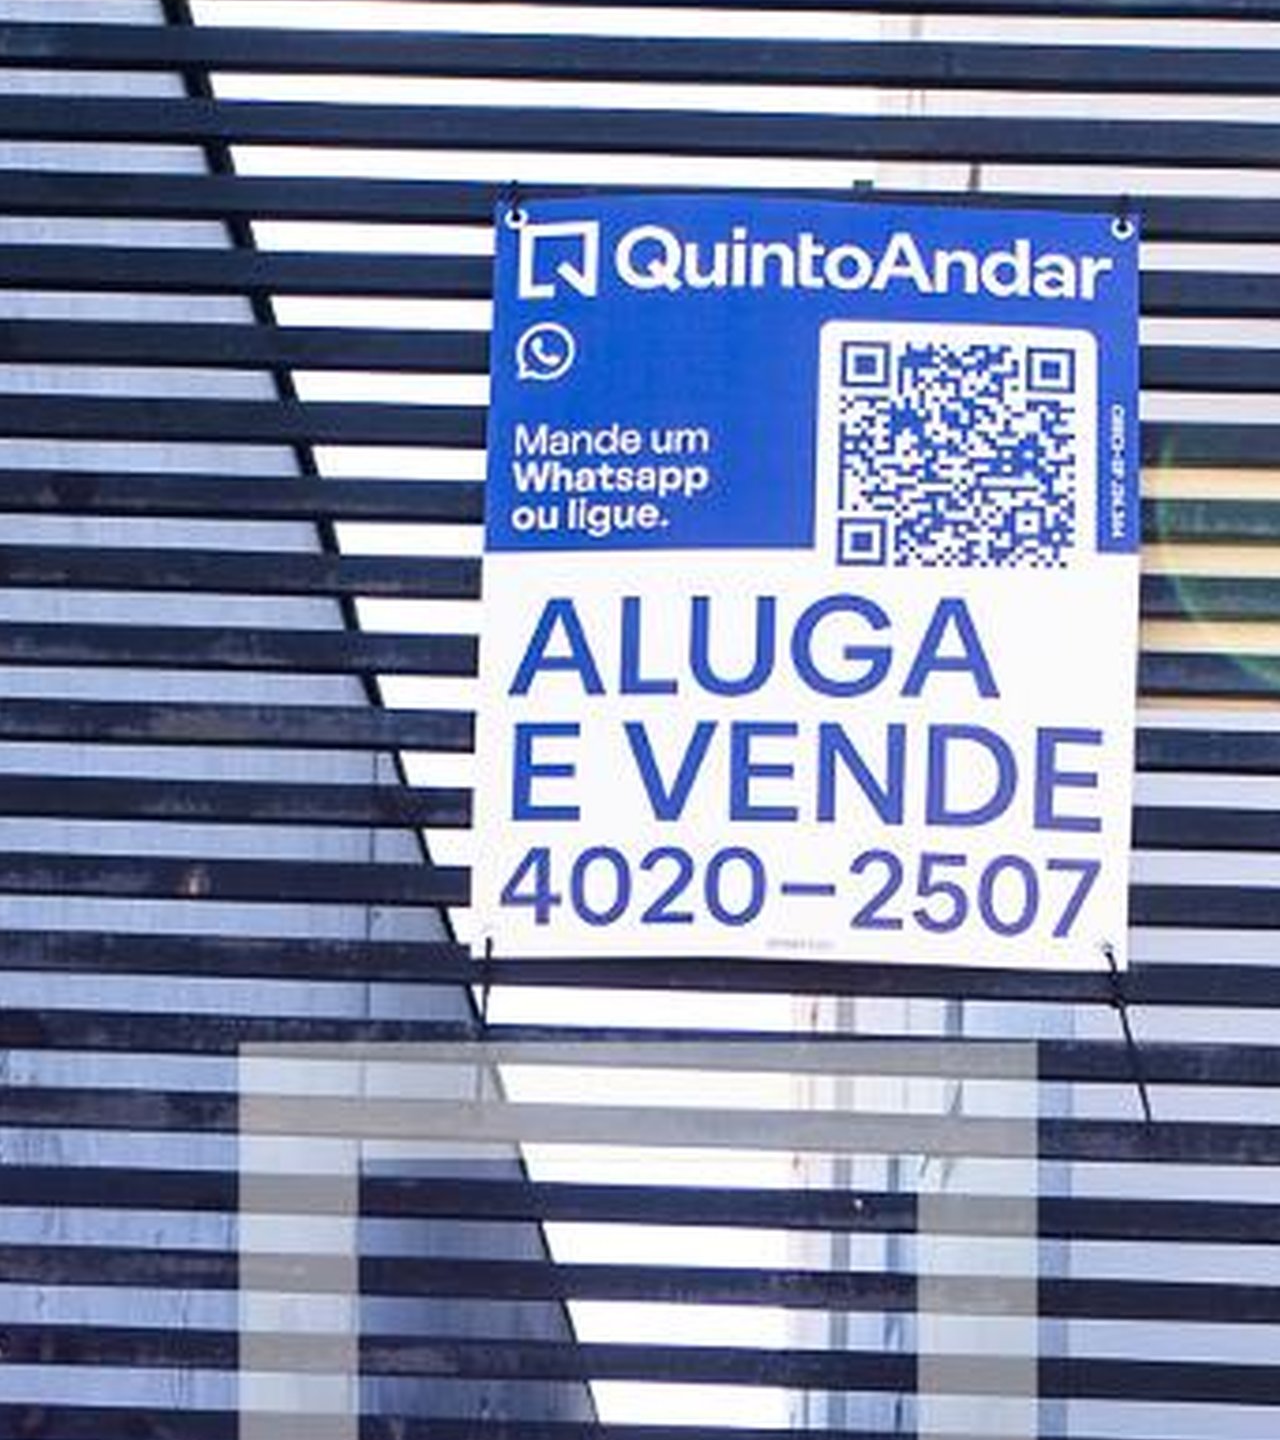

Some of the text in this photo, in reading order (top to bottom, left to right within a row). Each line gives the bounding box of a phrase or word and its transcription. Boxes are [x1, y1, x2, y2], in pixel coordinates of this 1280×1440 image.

[615, 224, 1114, 303] QuintoAndar
[513, 422, 710, 456] Mande um
[510, 497, 670, 537] ou ligue.
[511, 461, 710, 497] Whatsapp
[507, 592, 1001, 699] ALUGA
[509, 718, 1106, 835] E VENDE
[499, 844, 1102, 940] 4020-2507
